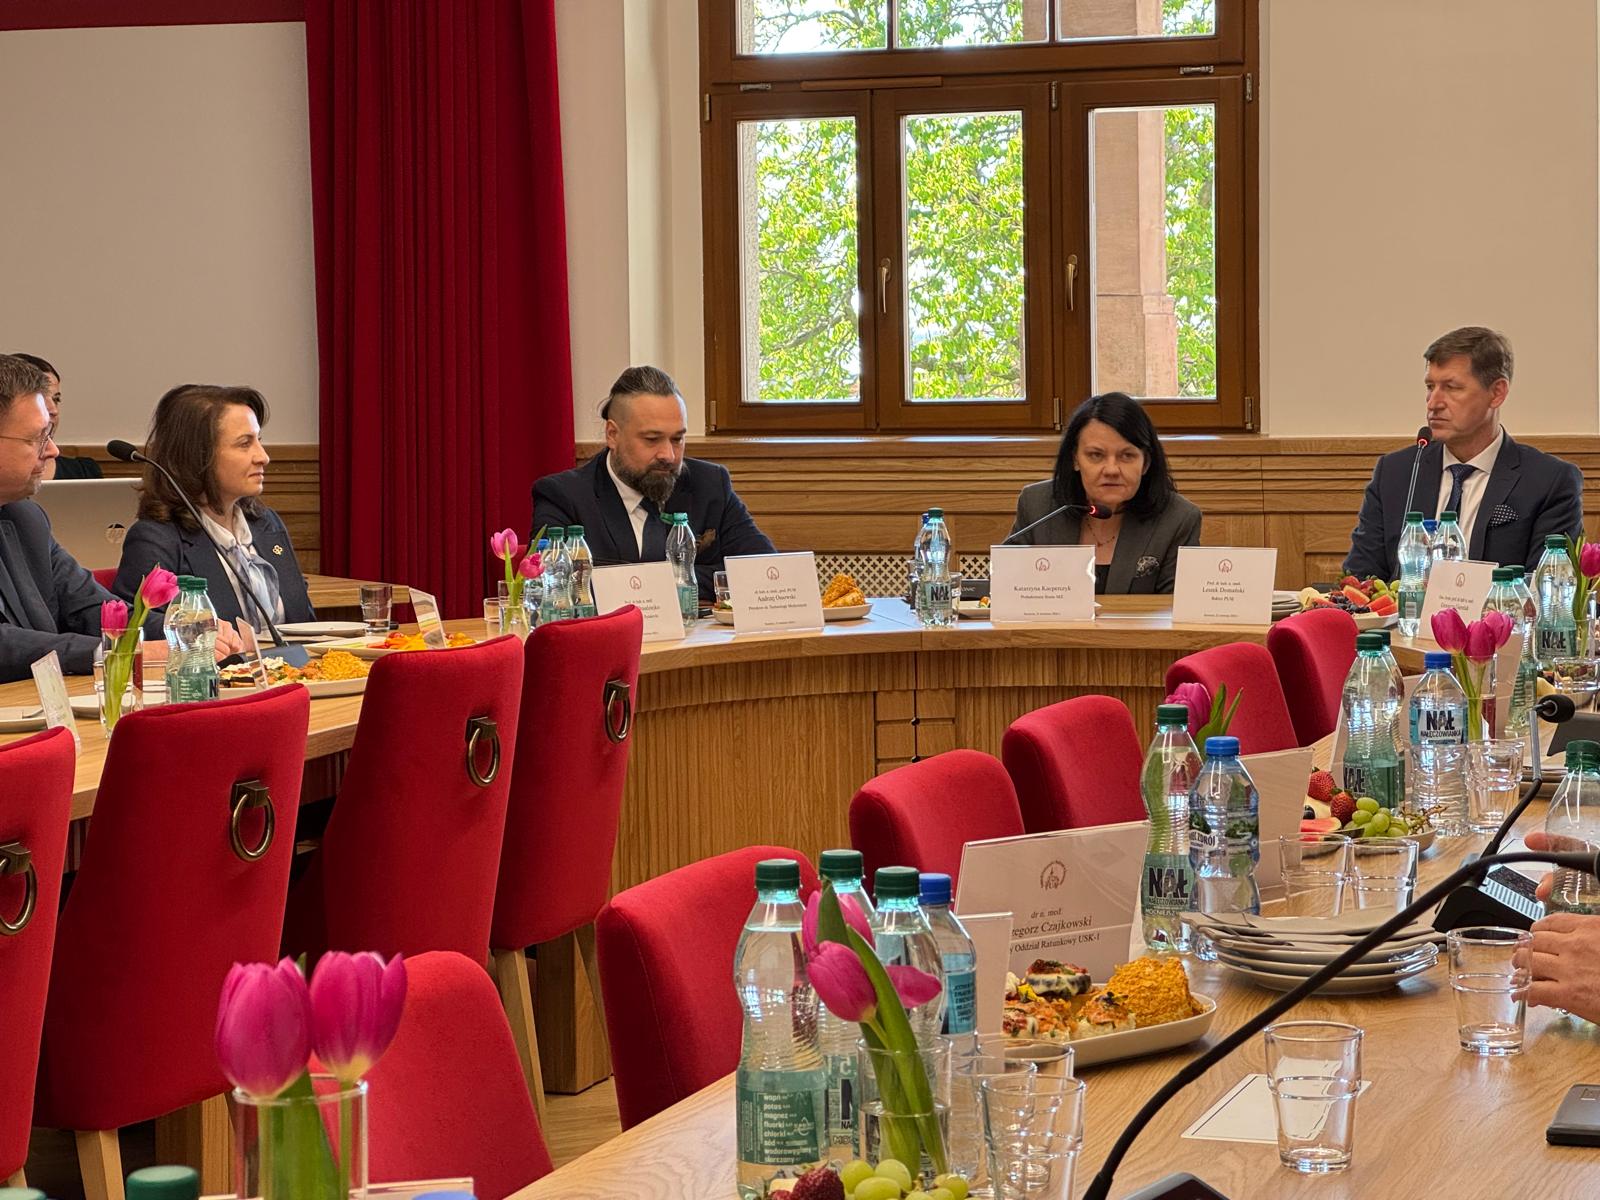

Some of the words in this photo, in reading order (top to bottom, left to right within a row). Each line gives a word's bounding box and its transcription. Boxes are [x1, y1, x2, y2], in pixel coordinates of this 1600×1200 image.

[1426, 710, 1455, 731] NAŁ
[1148, 867, 1189, 899] NAŁ
[1041, 916, 1093, 934] Czajkowski
[1015, 942, 1040, 953] Oddział
[1041, 937, 1078, 950] Ratunkowy
